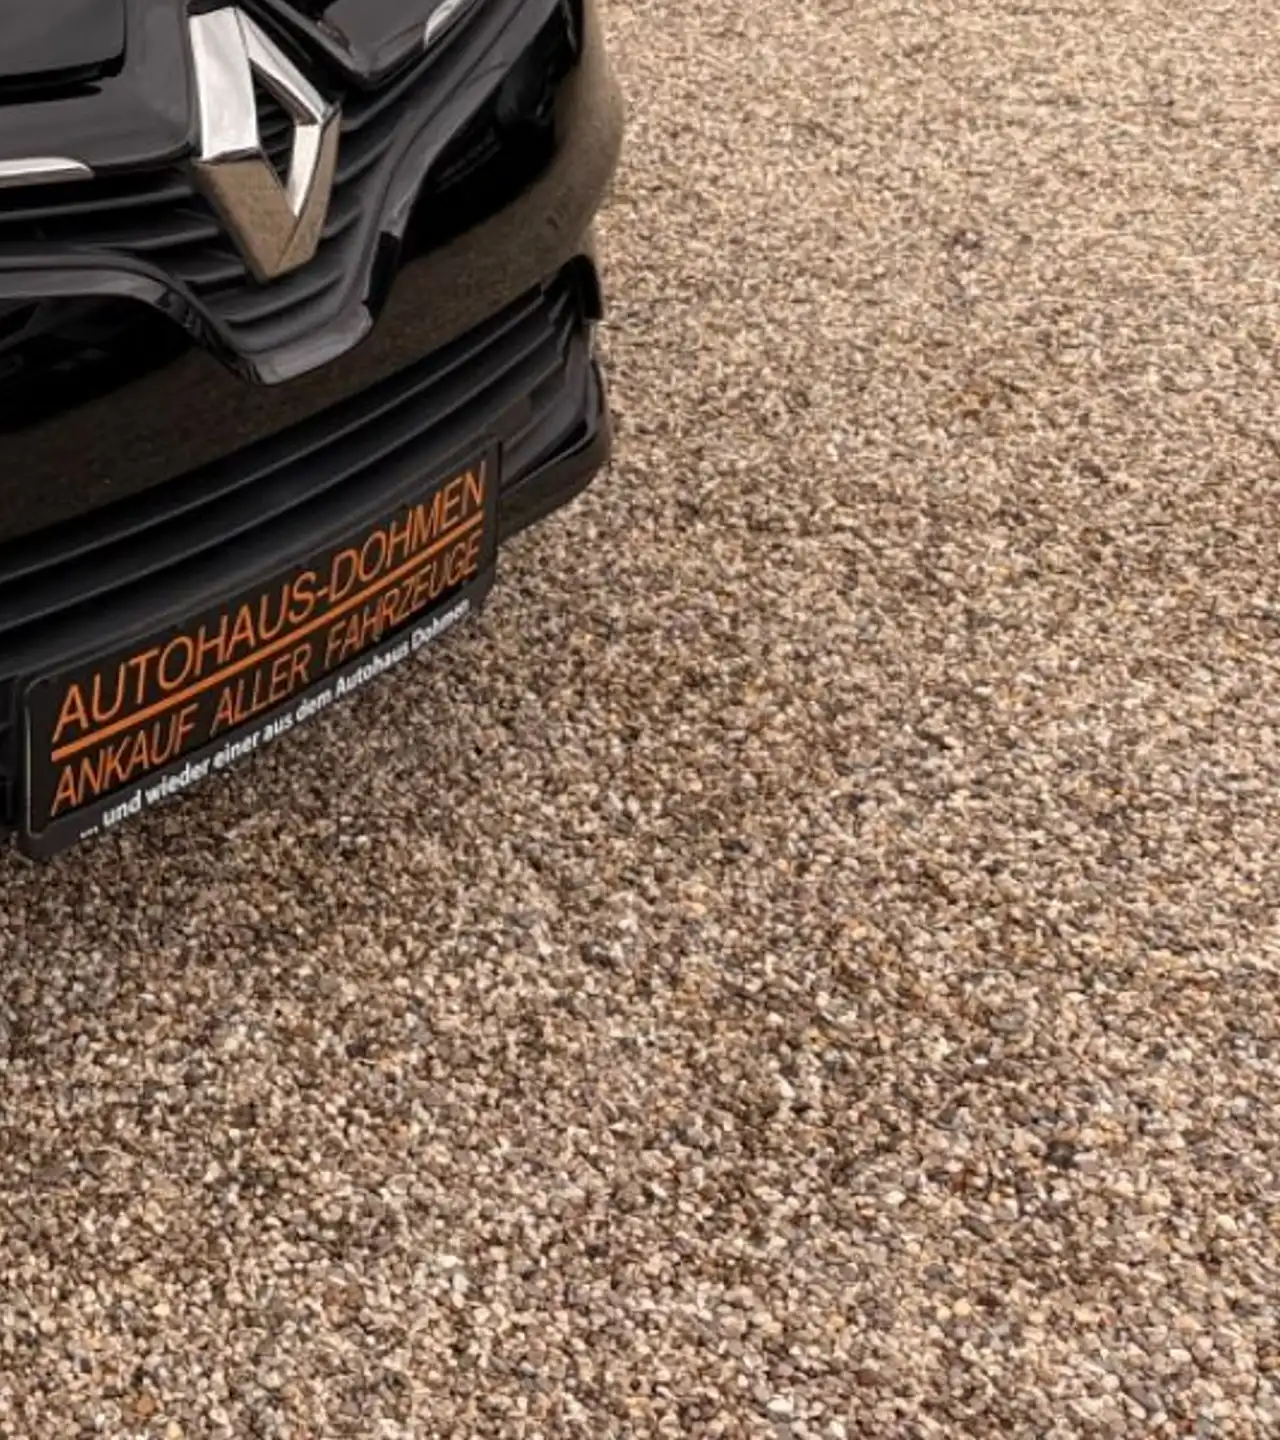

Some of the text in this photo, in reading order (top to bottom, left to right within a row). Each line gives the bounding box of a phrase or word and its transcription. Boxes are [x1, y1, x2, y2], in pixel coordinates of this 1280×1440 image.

[51, 459, 487, 744] AUTOHAUS-DOHMEN
[51, 528, 484, 817] ANKAUF ALLER FAHRZEUGE
[102, 788, 142, 828] und
[144, 757, 211, 805] wieder
[213, 729, 261, 769] einer
[262, 710, 294, 743] aus
[295, 687, 333, 721] dem
[335, 640, 410, 699] Autohaus
